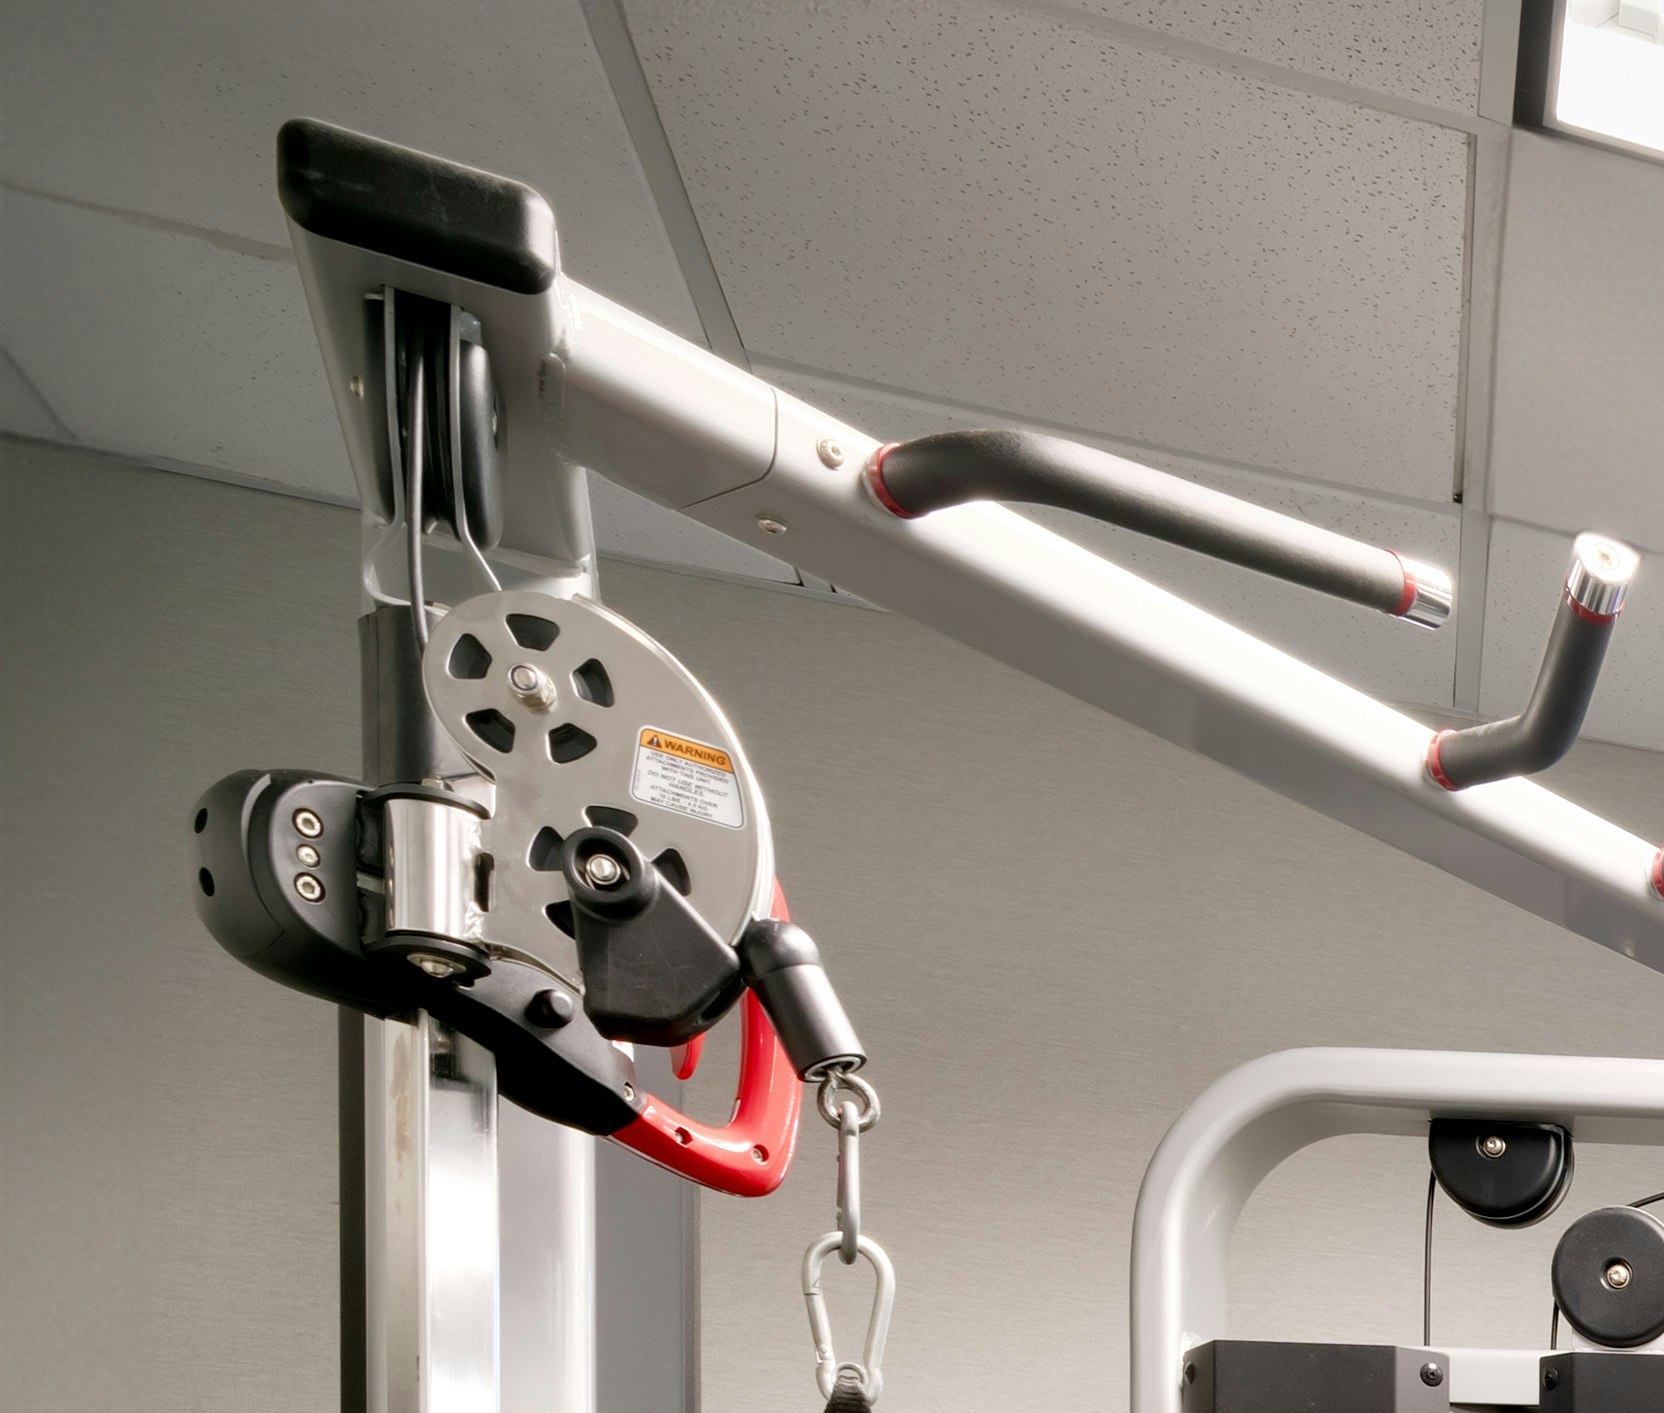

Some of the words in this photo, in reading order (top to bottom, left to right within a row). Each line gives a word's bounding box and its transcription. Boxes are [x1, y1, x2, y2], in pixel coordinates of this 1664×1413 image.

[664, 739, 726, 765] WARNING
[648, 770, 659, 778] DO
[661, 773, 676, 782] NOT
[678, 779, 692, 787] USE
[694, 783, 729, 798] WITHOUT
